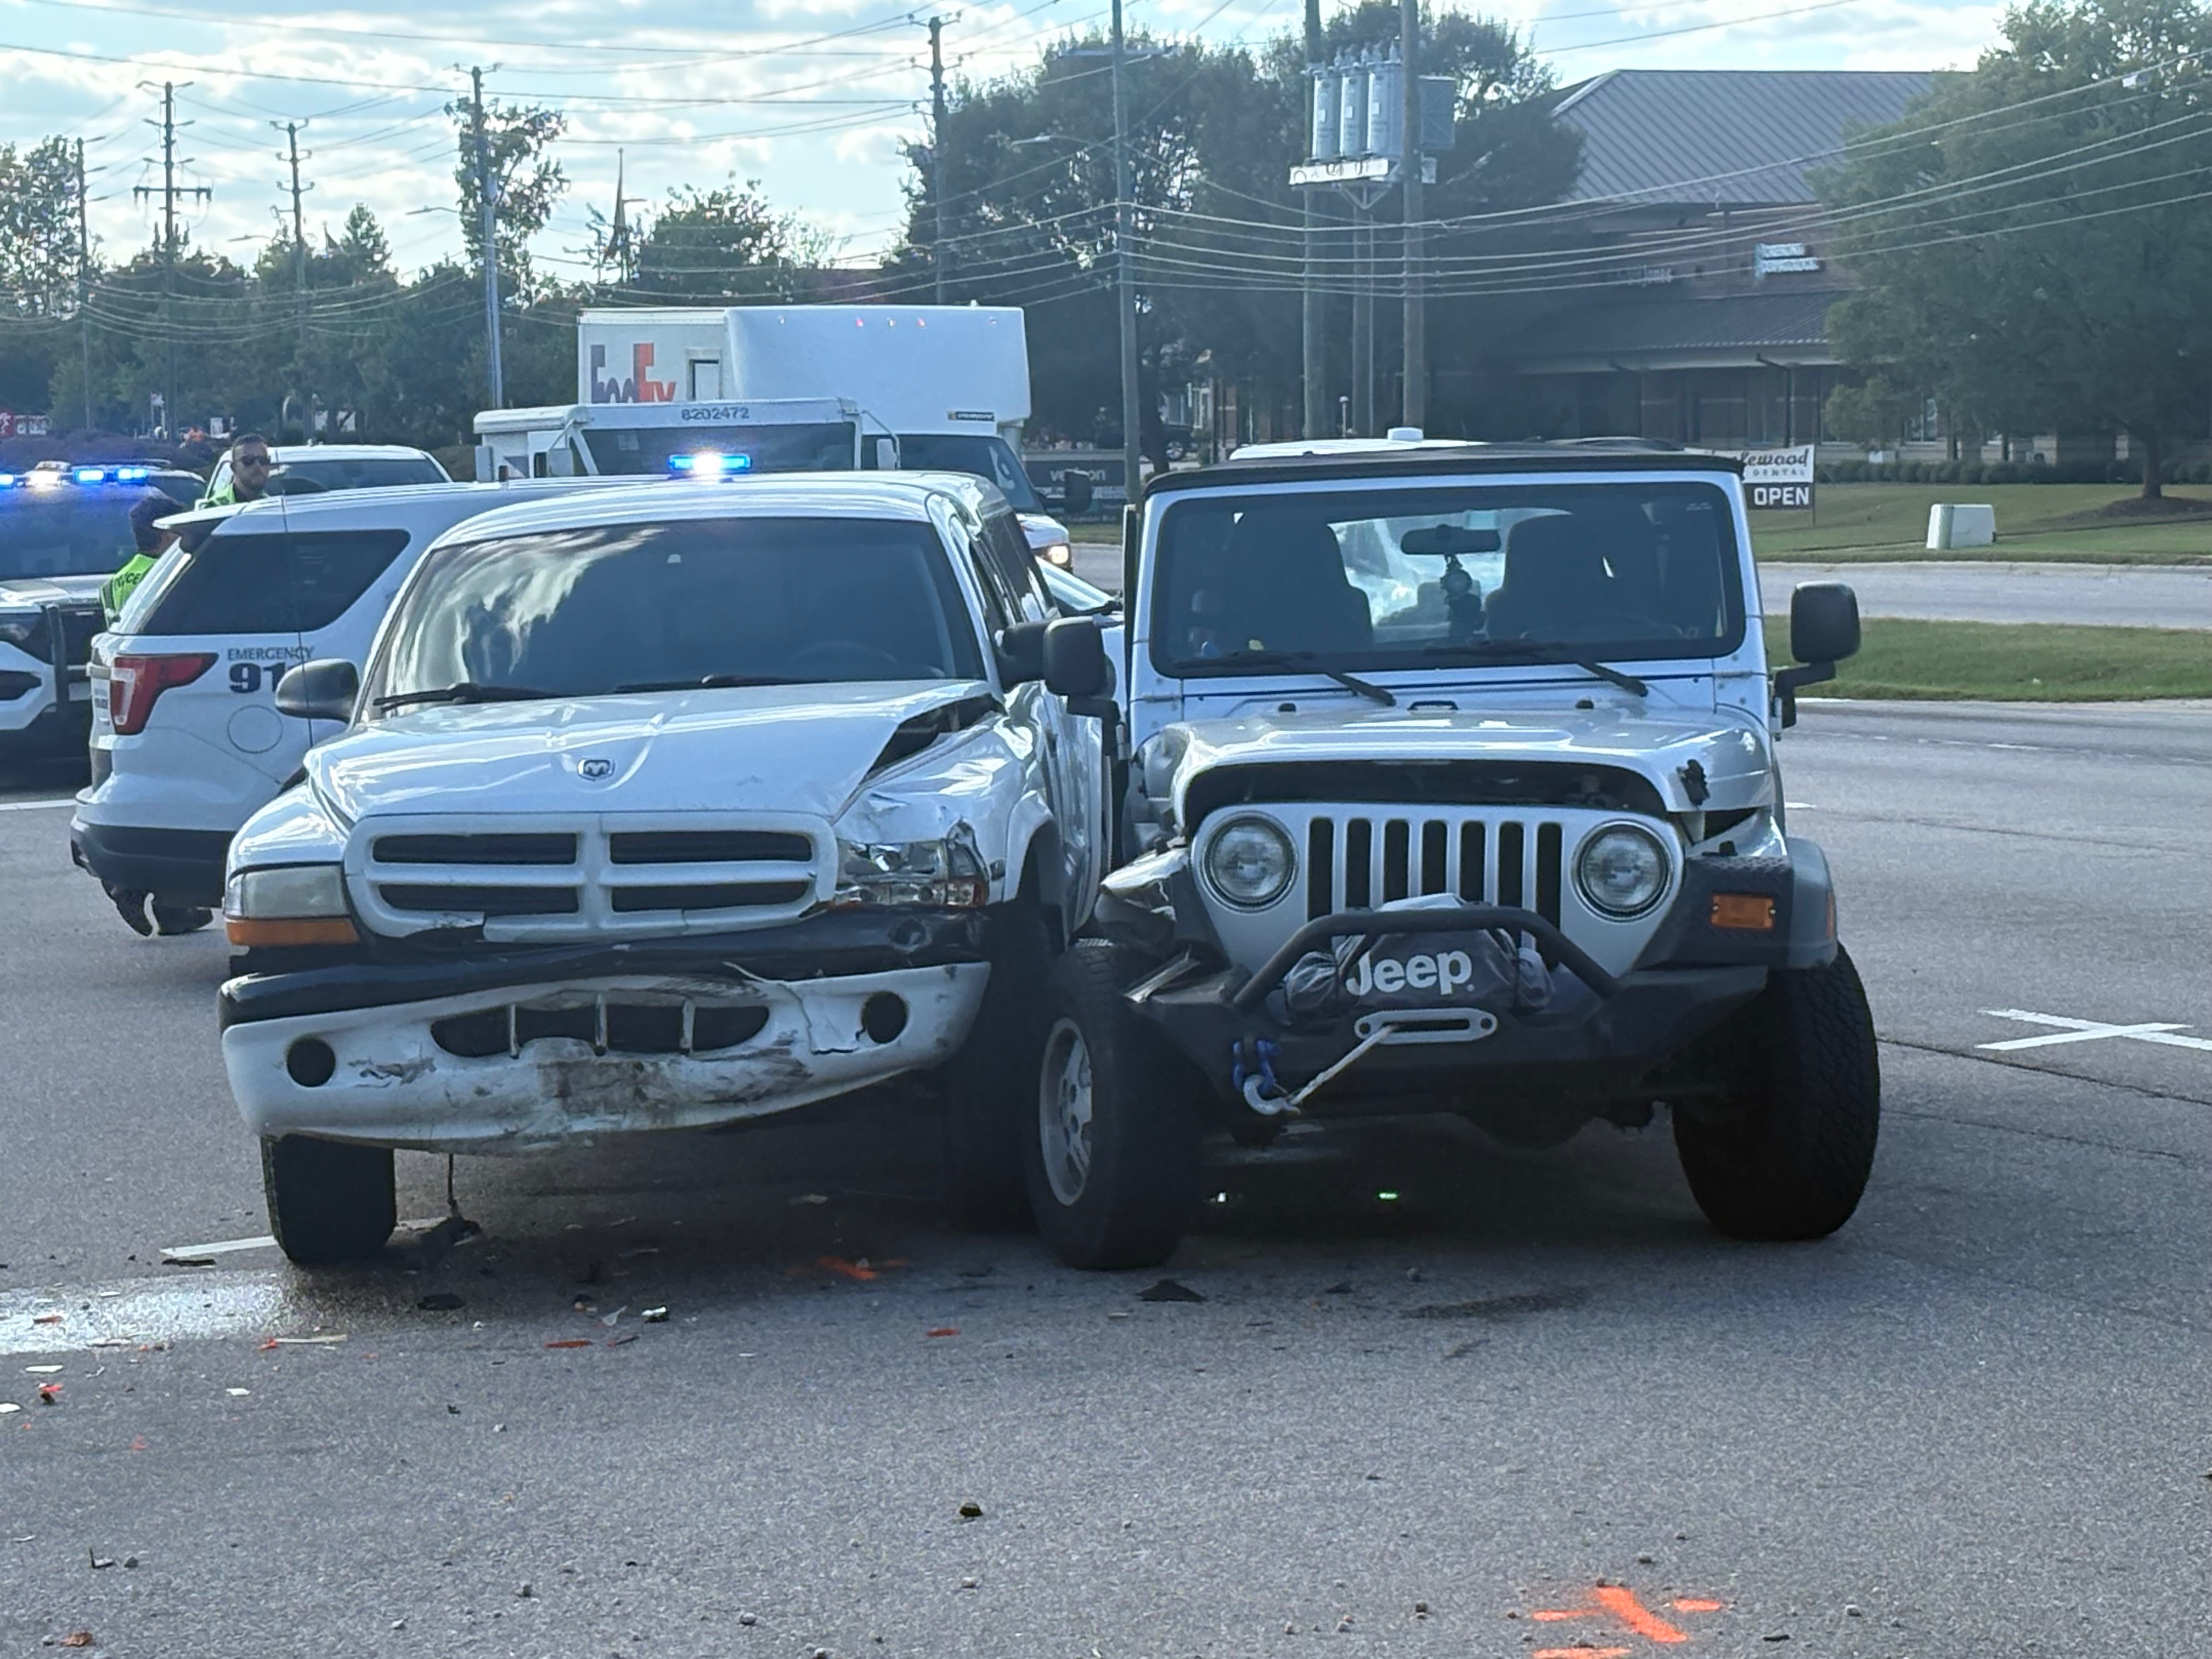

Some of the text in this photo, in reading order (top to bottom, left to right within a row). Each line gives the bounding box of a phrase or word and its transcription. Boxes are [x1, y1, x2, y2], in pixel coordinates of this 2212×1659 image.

[681, 407, 749, 420] 8202472
[1050, 469, 1105, 481] veon
[1754, 487, 1809, 505] OPEN
[228, 646, 315, 661] EMERGENCY
[229, 662, 302, 693] 91
[1346, 950, 1472, 996] Jeep
